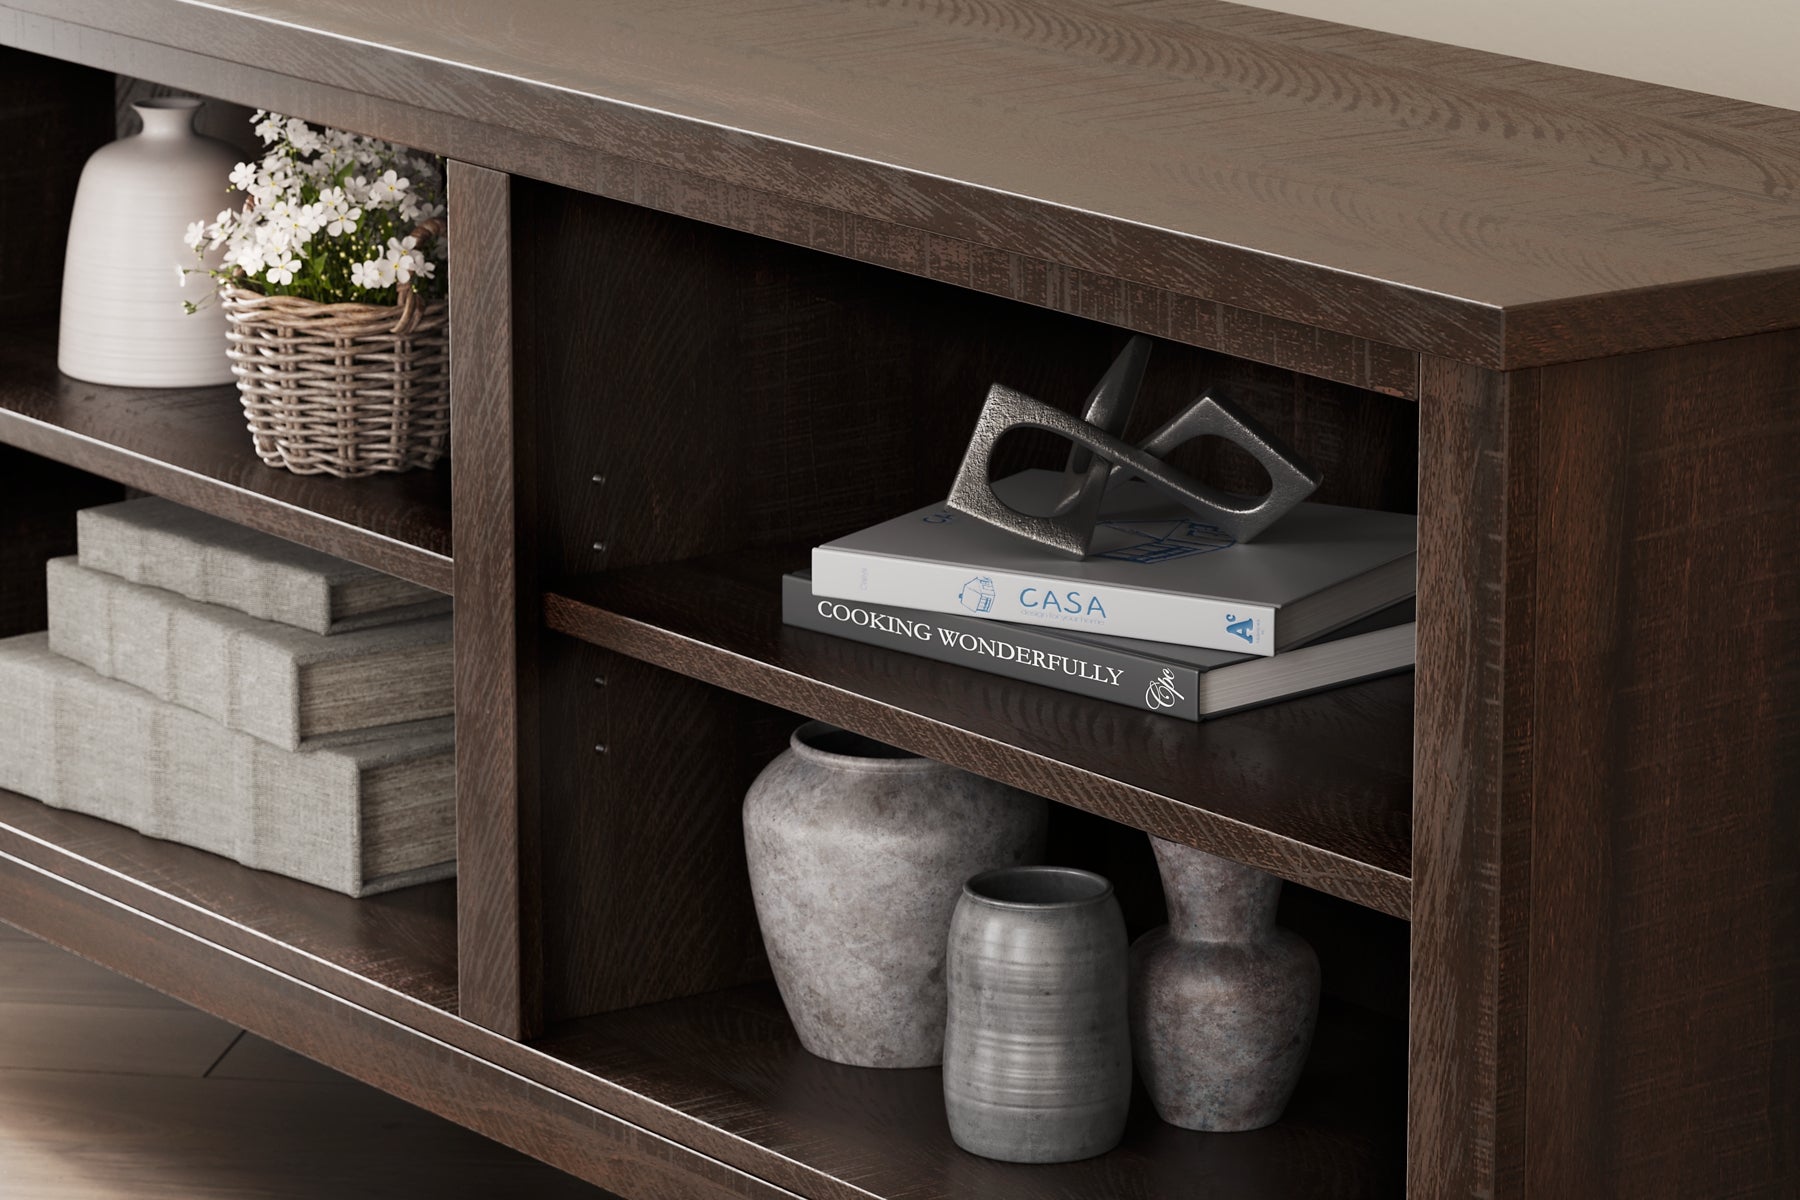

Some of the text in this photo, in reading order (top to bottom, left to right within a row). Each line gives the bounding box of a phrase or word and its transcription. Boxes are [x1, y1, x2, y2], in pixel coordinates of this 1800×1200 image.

[1019, 587, 1107, 619] CASA
[817, 600, 1125, 687] COOKING WONDERFULLY
